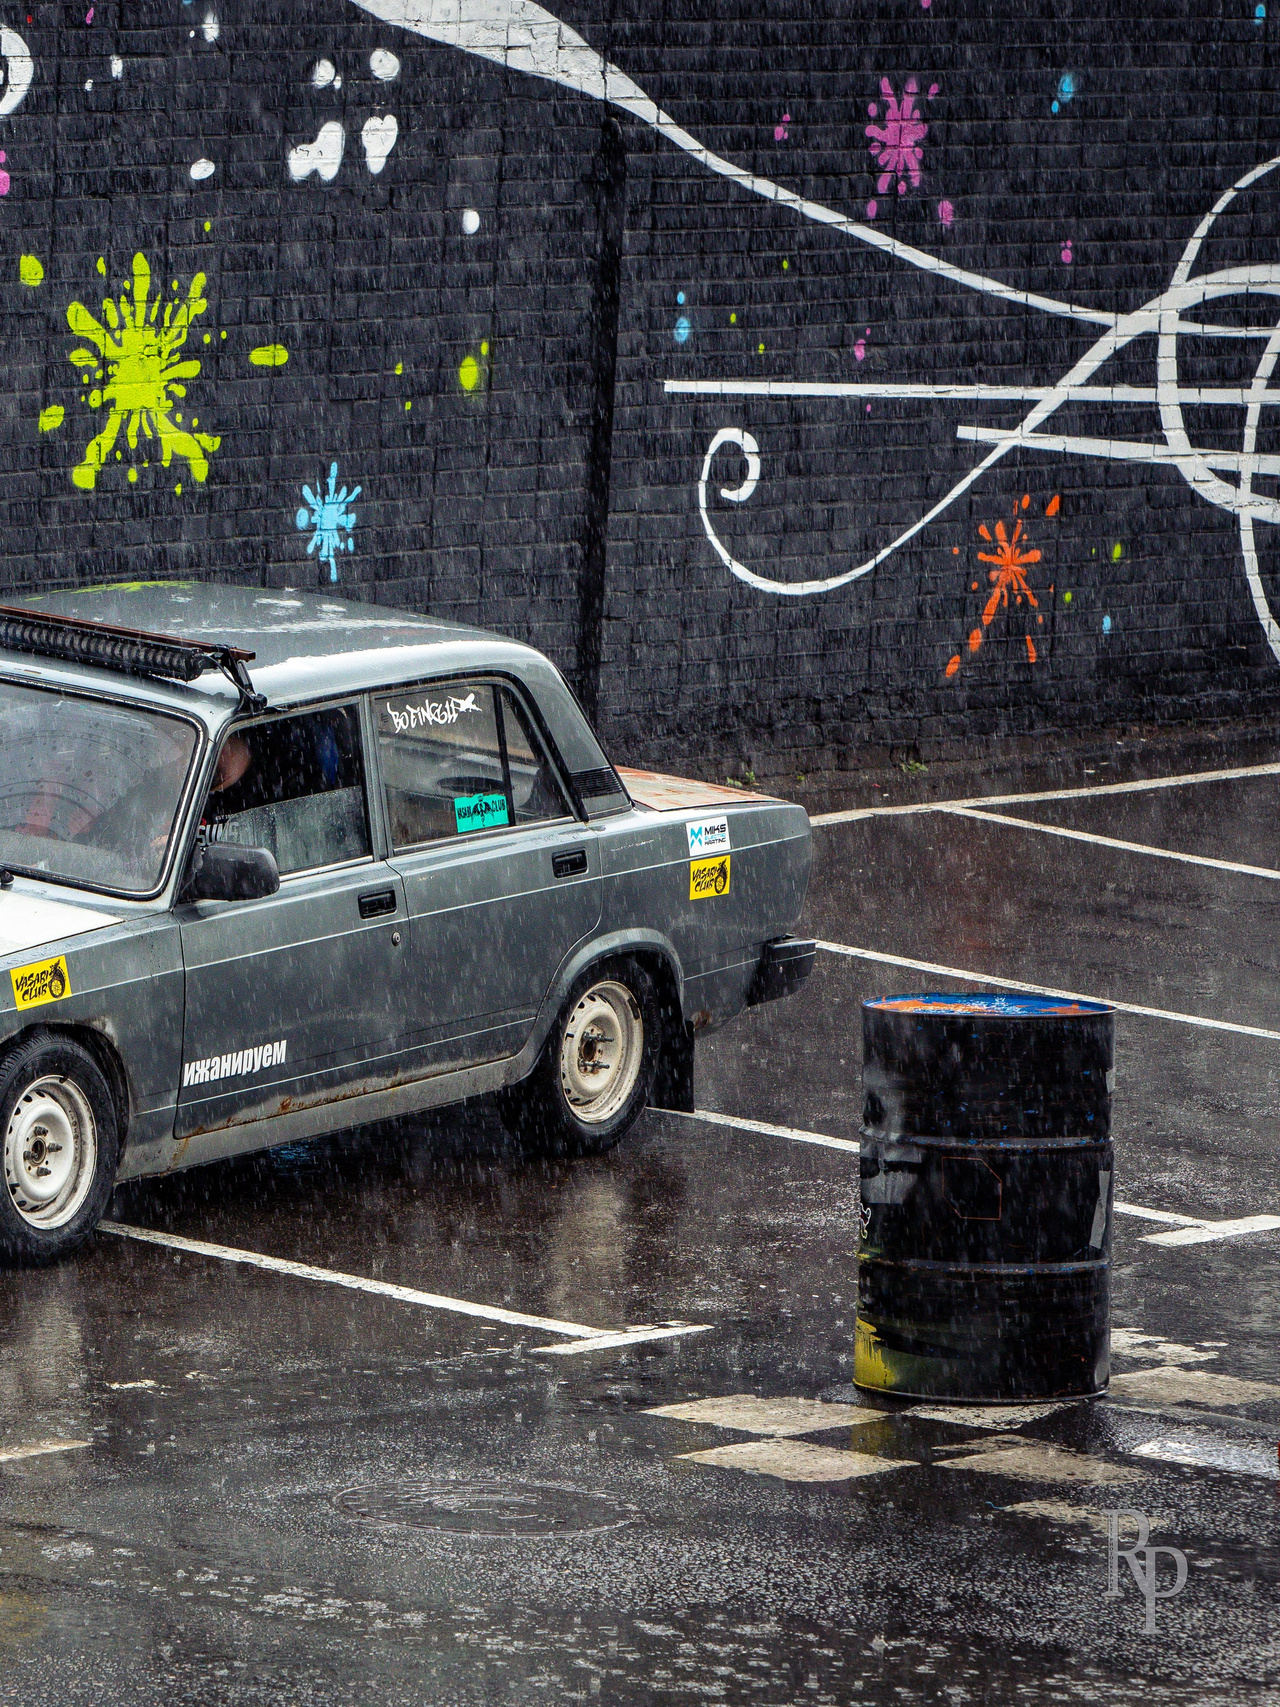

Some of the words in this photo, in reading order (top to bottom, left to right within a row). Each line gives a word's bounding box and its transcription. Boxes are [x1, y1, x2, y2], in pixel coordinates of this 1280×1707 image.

[704, 823, 726, 835] MIKS
[695, 878, 715, 892] CLUB
[22, 983, 48, 1001] CLUB
[183, 1040, 287, 1087] ижанируем
